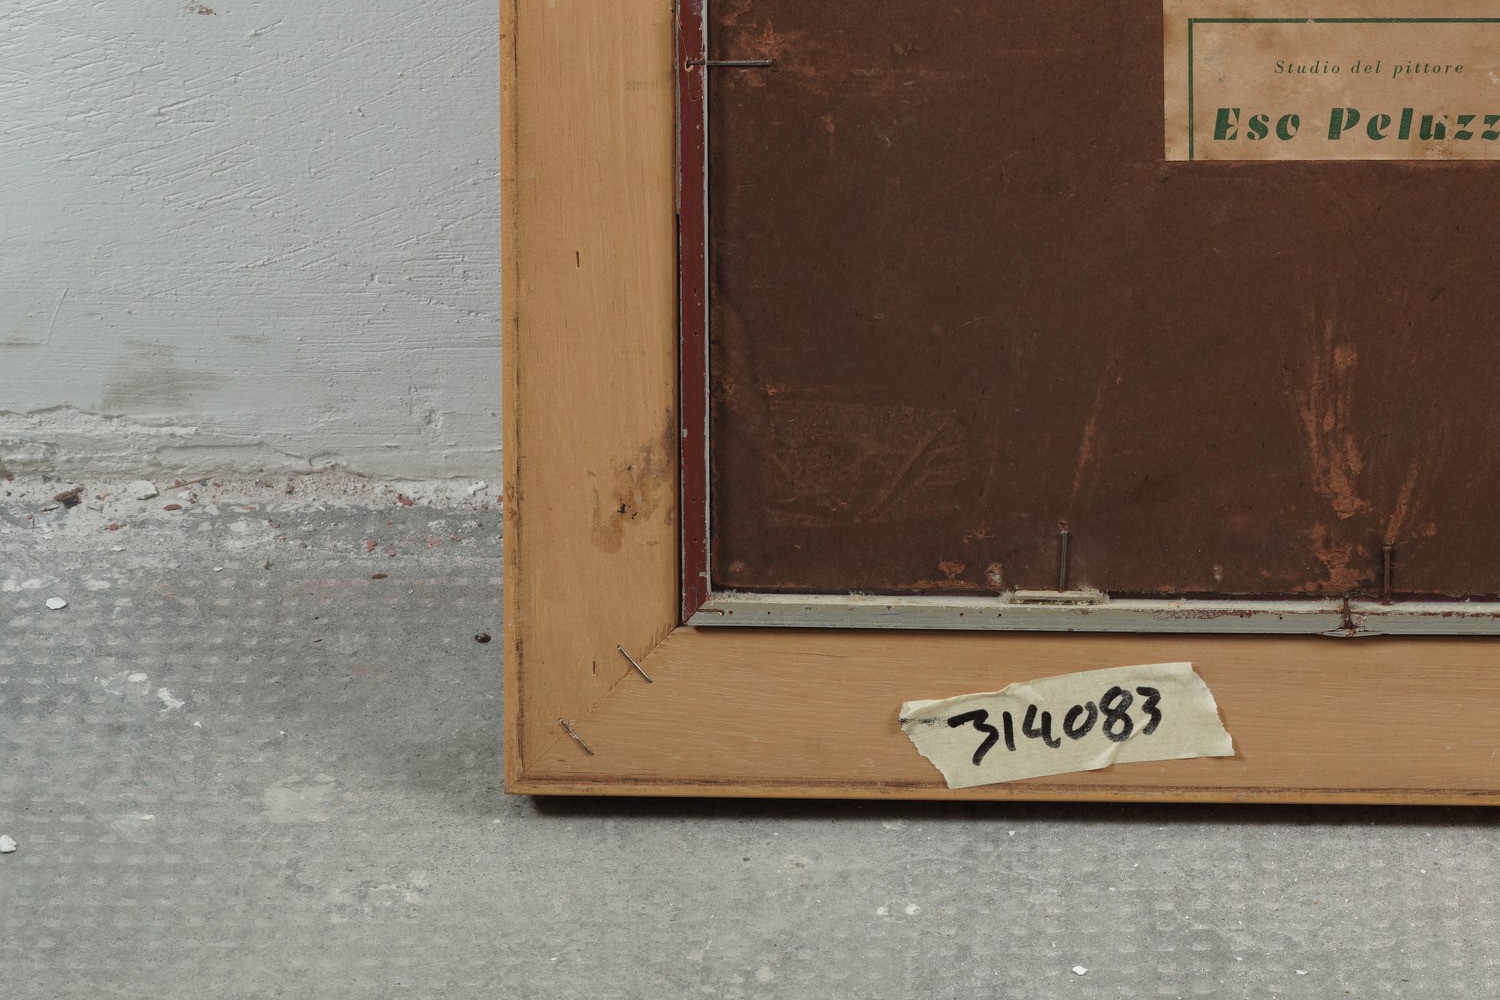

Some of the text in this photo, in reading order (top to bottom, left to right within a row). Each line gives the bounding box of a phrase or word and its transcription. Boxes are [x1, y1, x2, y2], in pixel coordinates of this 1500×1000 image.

[1273, 59, 1465, 80] Studio del pittore
[1213, 107, 1301, 142] Eso
[947, 685, 1163, 767] 314083
